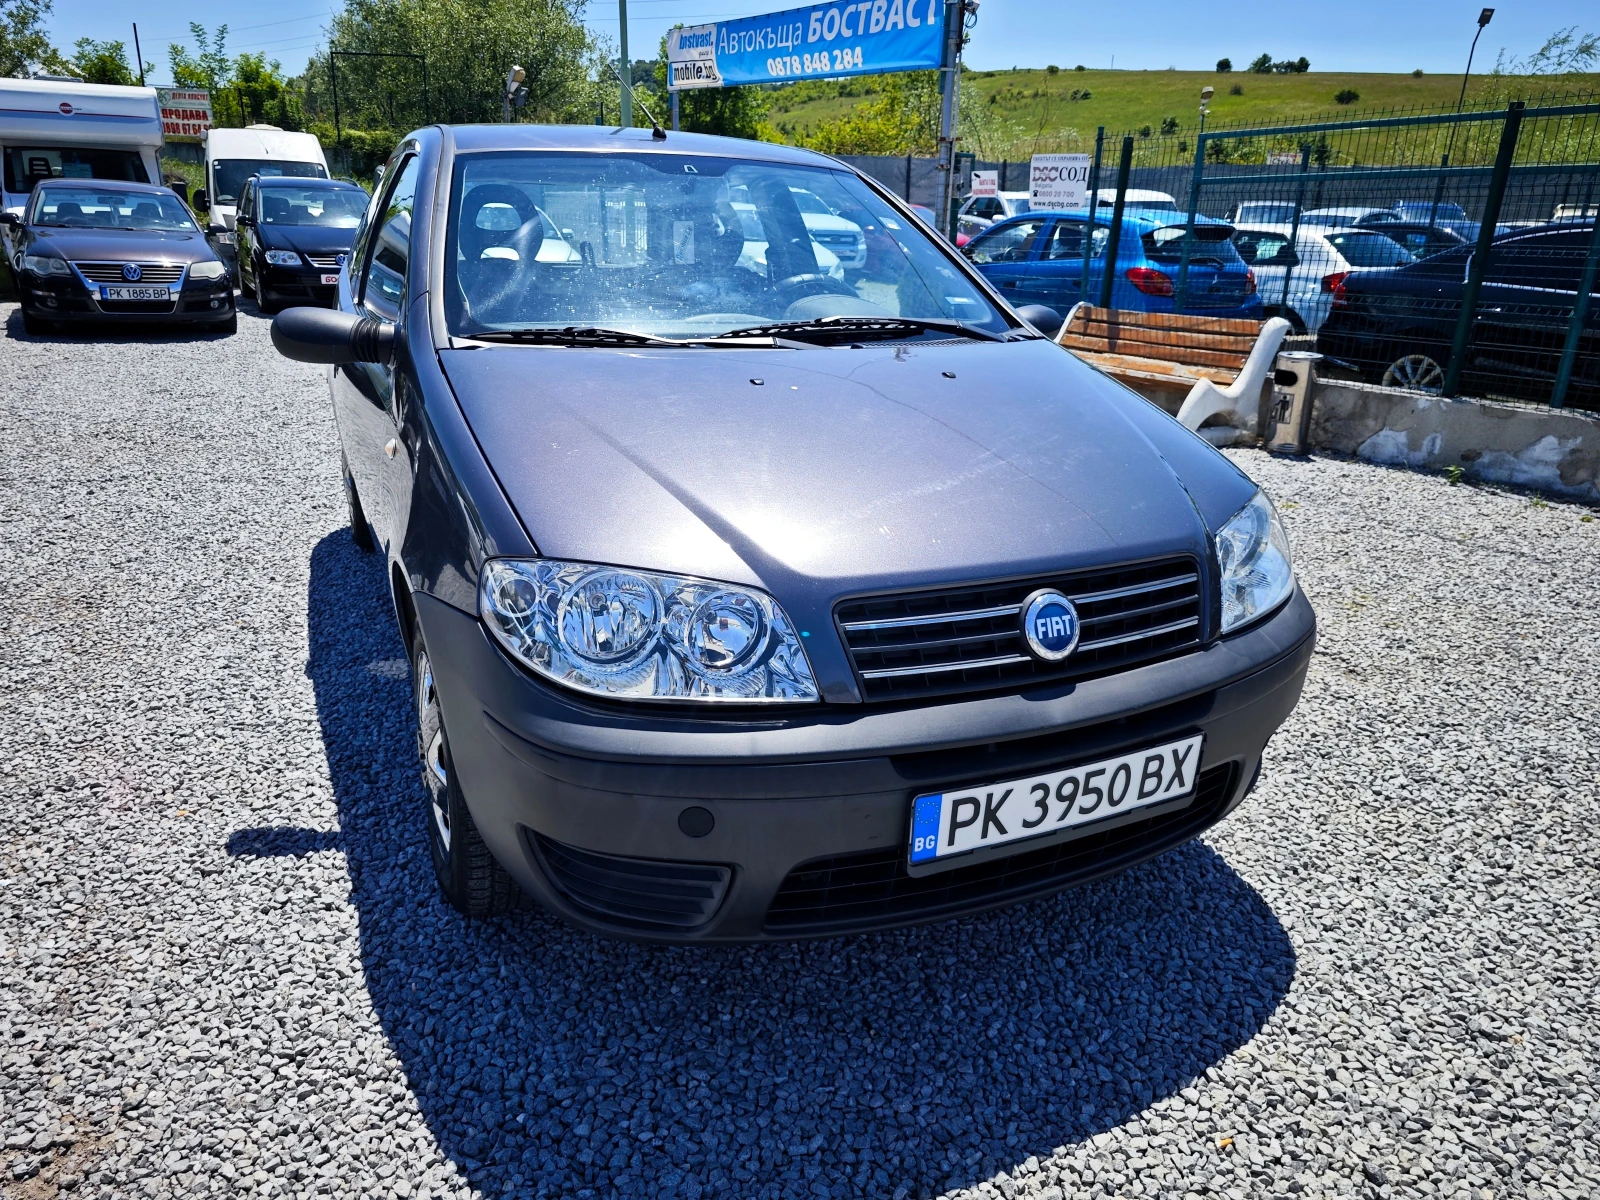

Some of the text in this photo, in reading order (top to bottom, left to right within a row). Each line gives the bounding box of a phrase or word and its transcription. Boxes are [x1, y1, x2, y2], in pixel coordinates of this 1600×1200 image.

[717, 0, 937, 56] Автокъща БОСТВАСТ
[767, 46, 863, 77] 0878 848 284
[673, 62, 718, 81] mobile.bg
[161, 108, 209, 121] ПРОДАВА
[181, 123, 191, 135] 67
[1059, 166, 1088, 184] СОД
[1053, 190, 1062, 198] 20
[1033, 200, 1080, 209] www.dscbg.com
[108, 288, 124, 299] PK
[126, 288, 152, 299] 1885
[152, 288, 167, 299] BP
[1036, 614, 1073, 640] FIAT
[947, 743, 1194, 847] PK 3950 BX
[914, 835, 936, 853] BG
